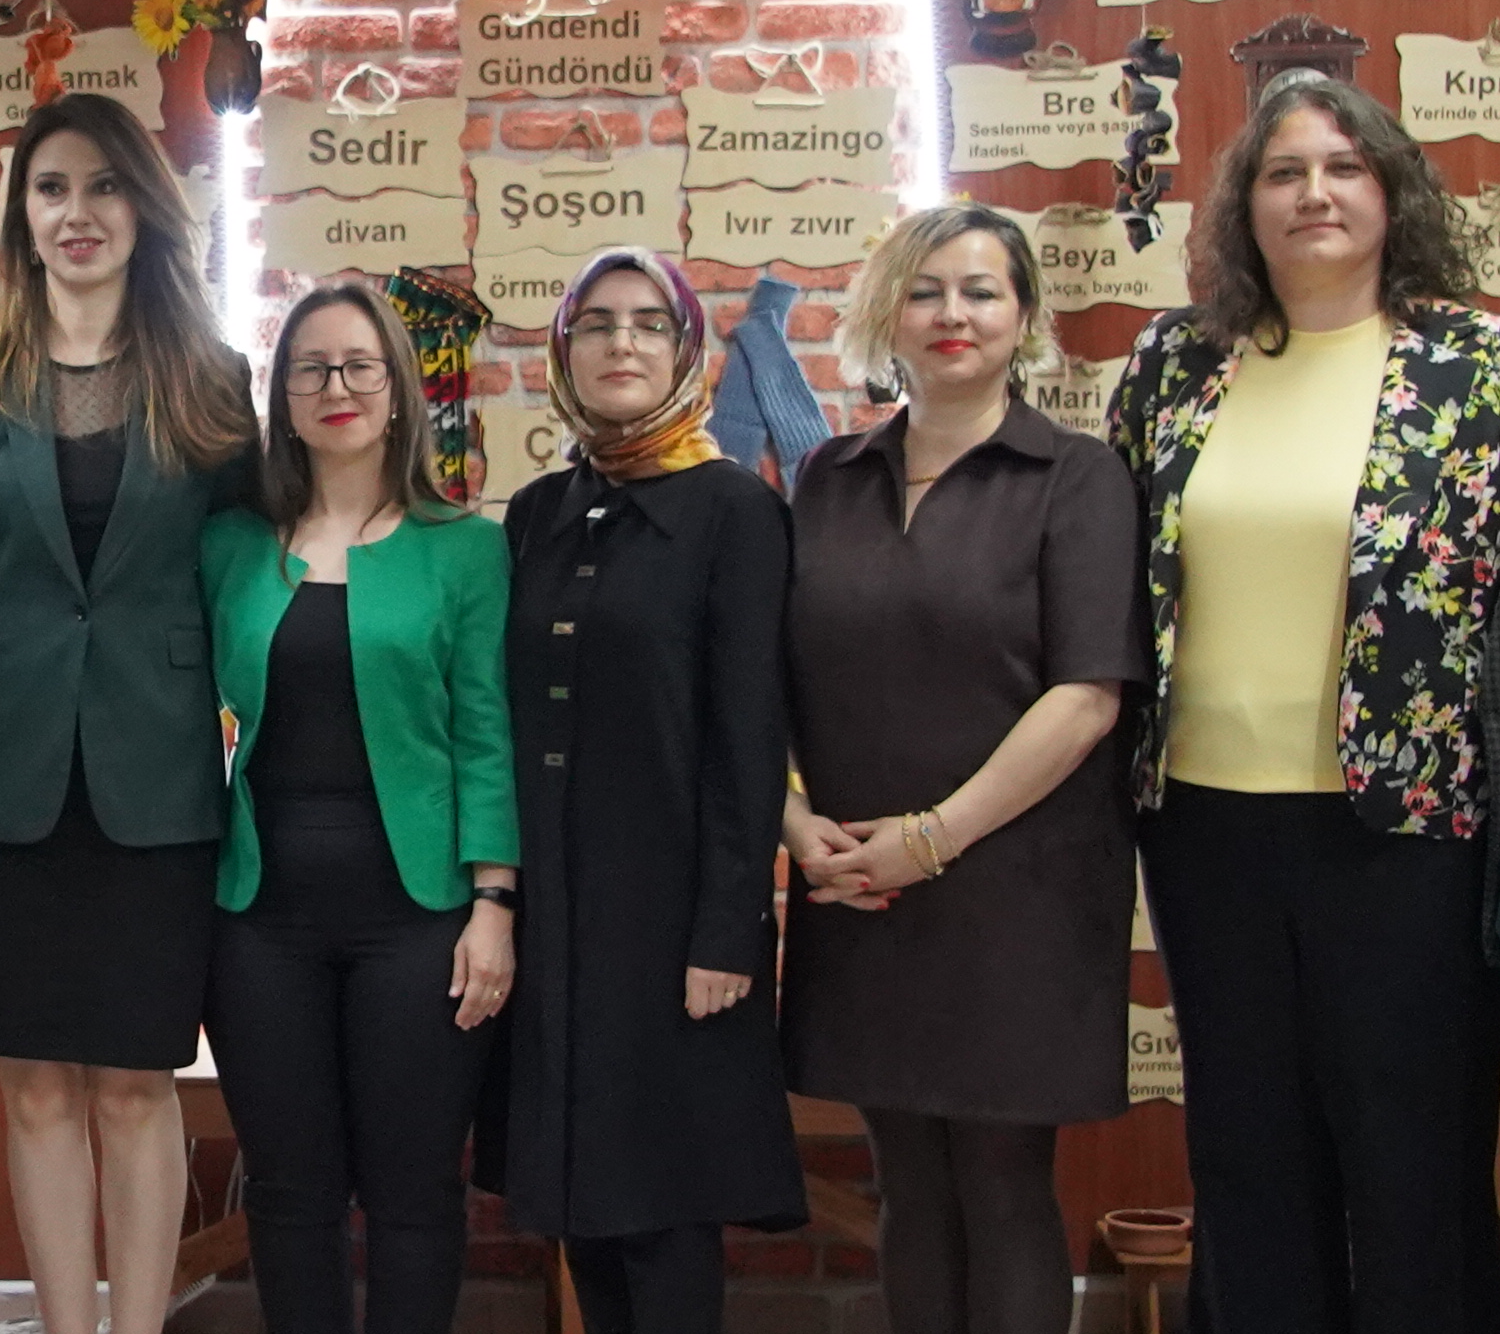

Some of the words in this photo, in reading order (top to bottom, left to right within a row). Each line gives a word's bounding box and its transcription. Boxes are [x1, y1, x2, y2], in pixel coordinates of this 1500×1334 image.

[477, 53, 654, 86] Gündöndü
[1042, 91, 1096, 117] Bre
[1411, 104, 1478, 121] Yerinde
[696, 123, 885, 158] Zamazingo
[968, 122, 1051, 139] Seslenme
[1056, 120, 1097, 137] veya
[307, 128, 428, 168] Sedir
[499, 182, 646, 229] Şoşon
[325, 218, 407, 244] divan
[789, 212, 857, 236] zıvır
[488, 274, 566, 301] örme
